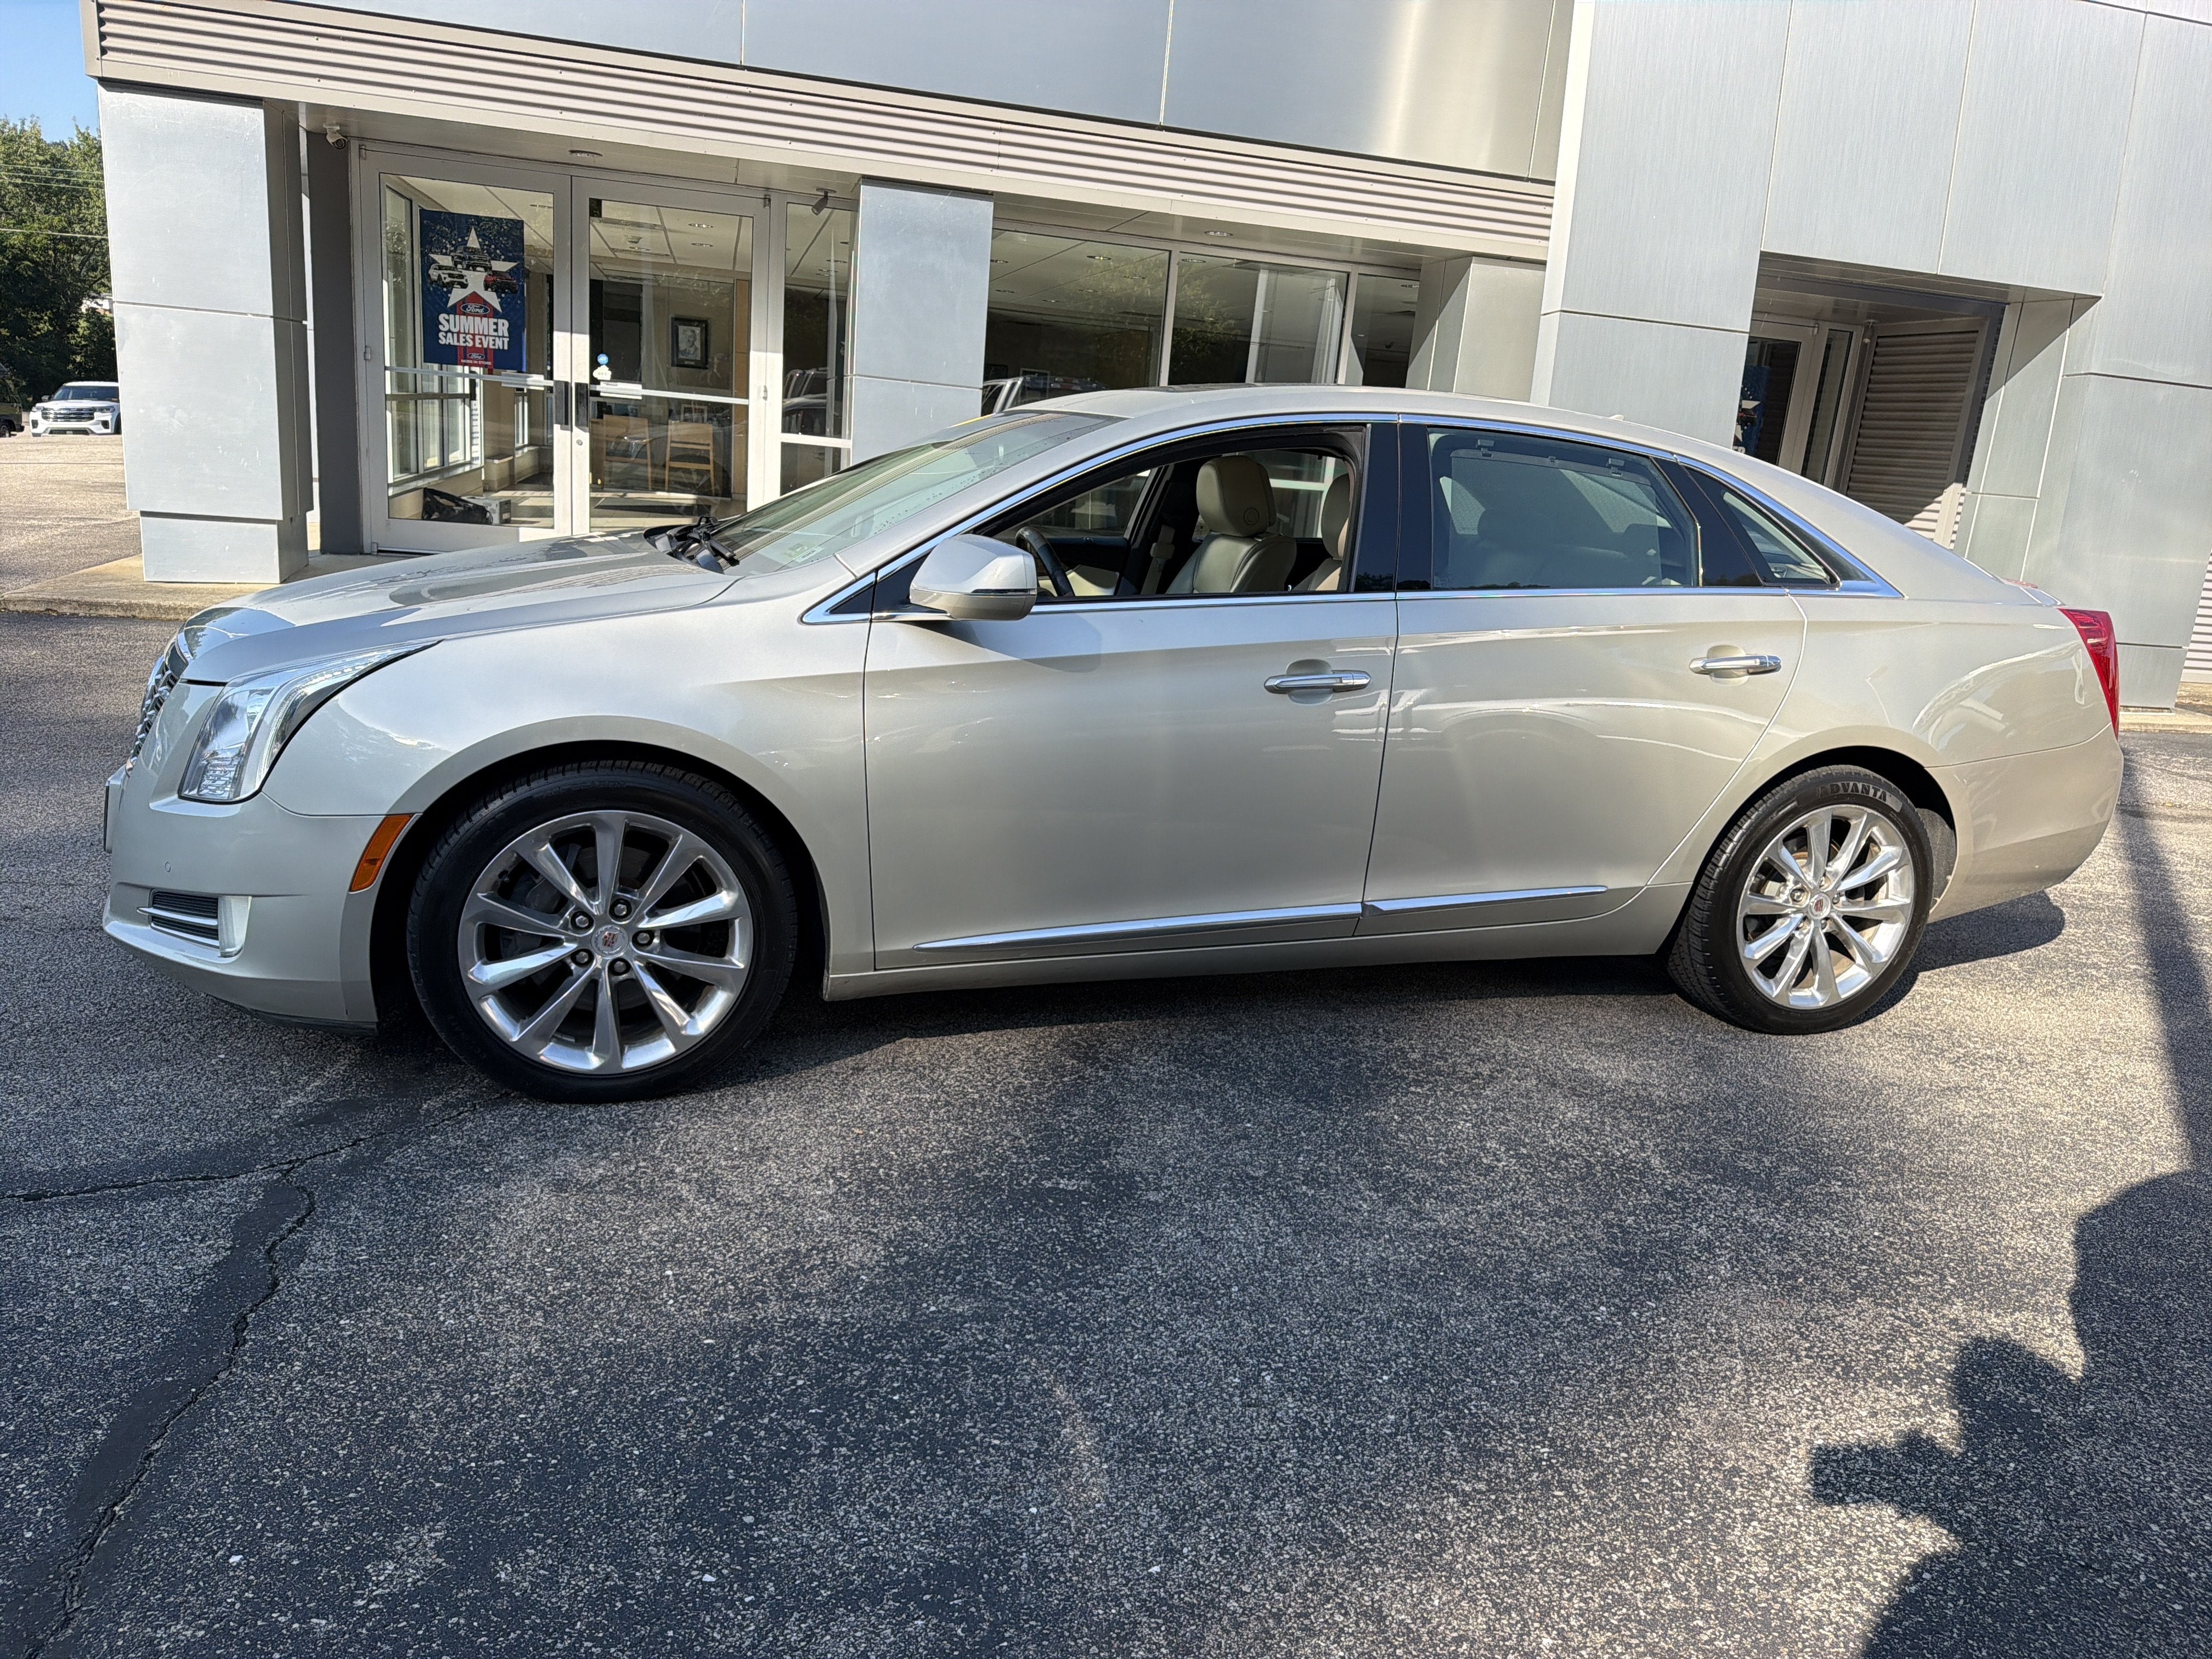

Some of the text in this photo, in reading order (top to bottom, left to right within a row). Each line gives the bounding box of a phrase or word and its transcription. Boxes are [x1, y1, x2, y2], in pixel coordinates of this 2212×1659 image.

[466, 304, 484, 313] Ford
[438, 313, 509, 337] SUMMER
[438, 331, 509, 350] SALES EVENT
